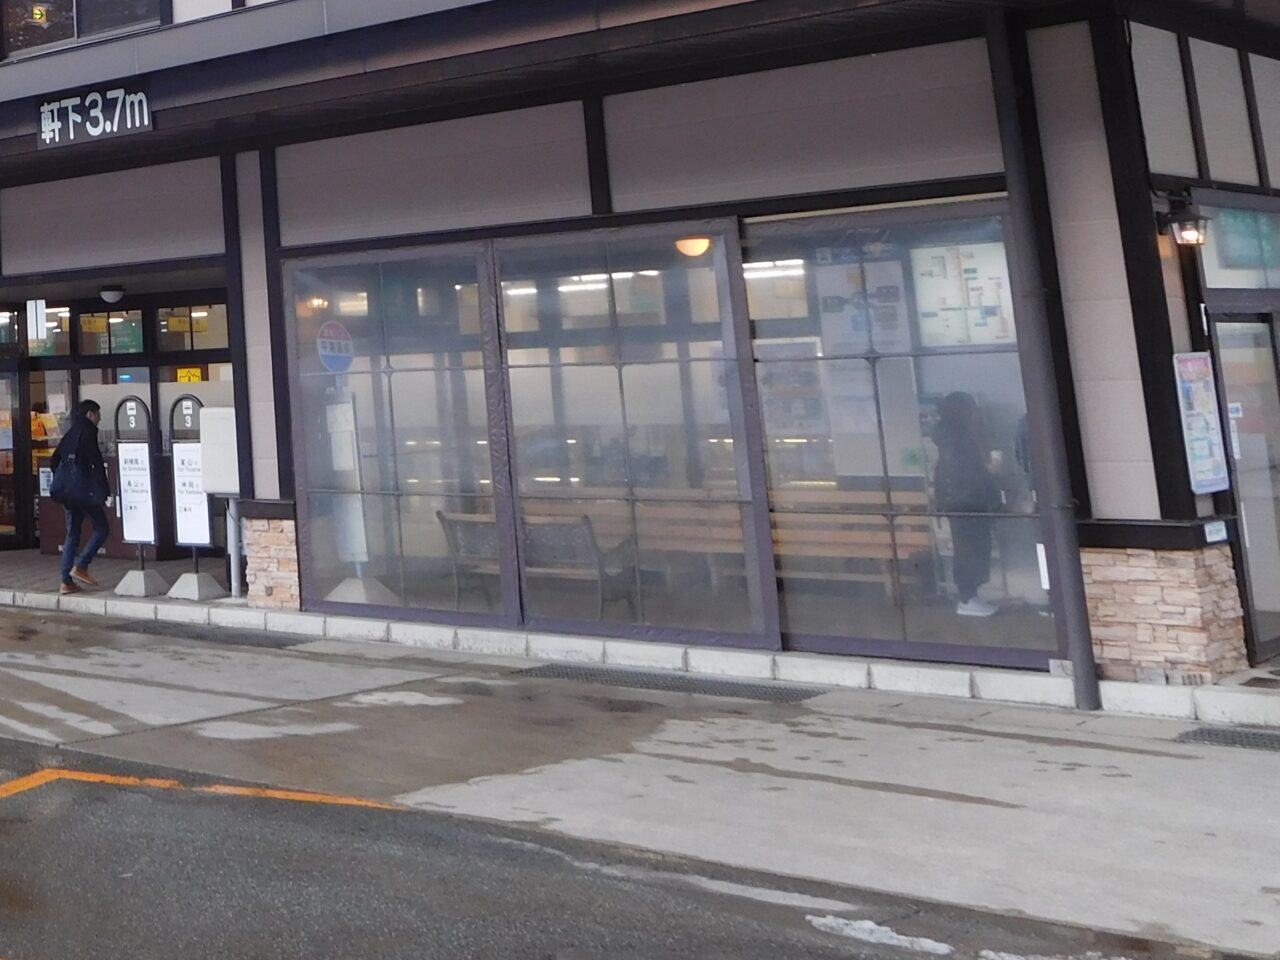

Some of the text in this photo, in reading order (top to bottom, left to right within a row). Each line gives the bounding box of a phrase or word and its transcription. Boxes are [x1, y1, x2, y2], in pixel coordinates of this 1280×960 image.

[39, 88, 149, 144] 軒下3.7m
[129, 416, 136, 428] 3
[184, 415, 192, 428] 3
